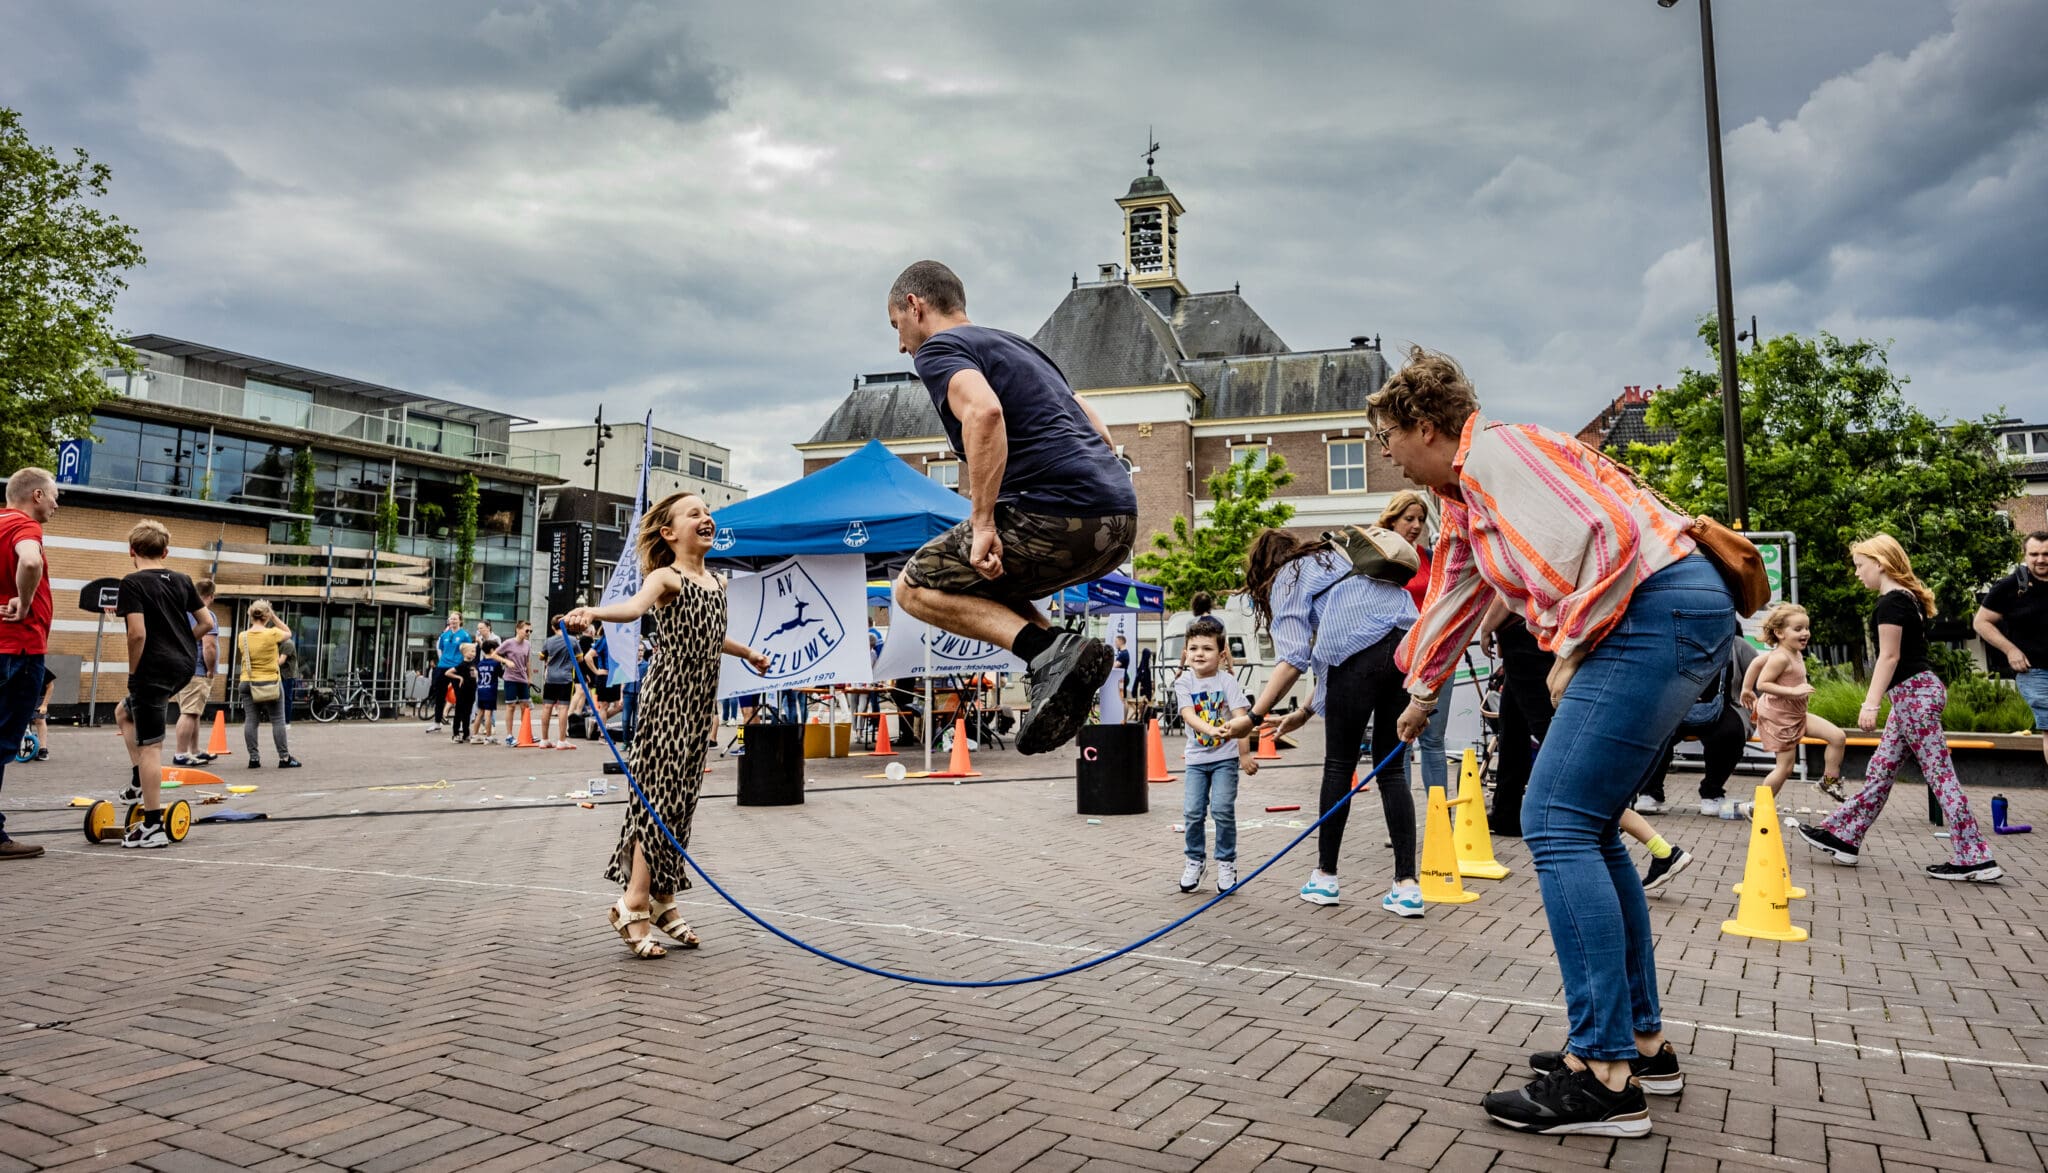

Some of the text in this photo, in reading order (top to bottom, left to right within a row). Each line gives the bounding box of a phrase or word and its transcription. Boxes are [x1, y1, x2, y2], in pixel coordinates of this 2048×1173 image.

[64, 453, 76, 475] P
[552, 531, 561, 583] BRASSERIE
[777, 573, 793, 597] AV
[783, 676, 811, 688] maart
[814, 671, 836, 682] 1970
